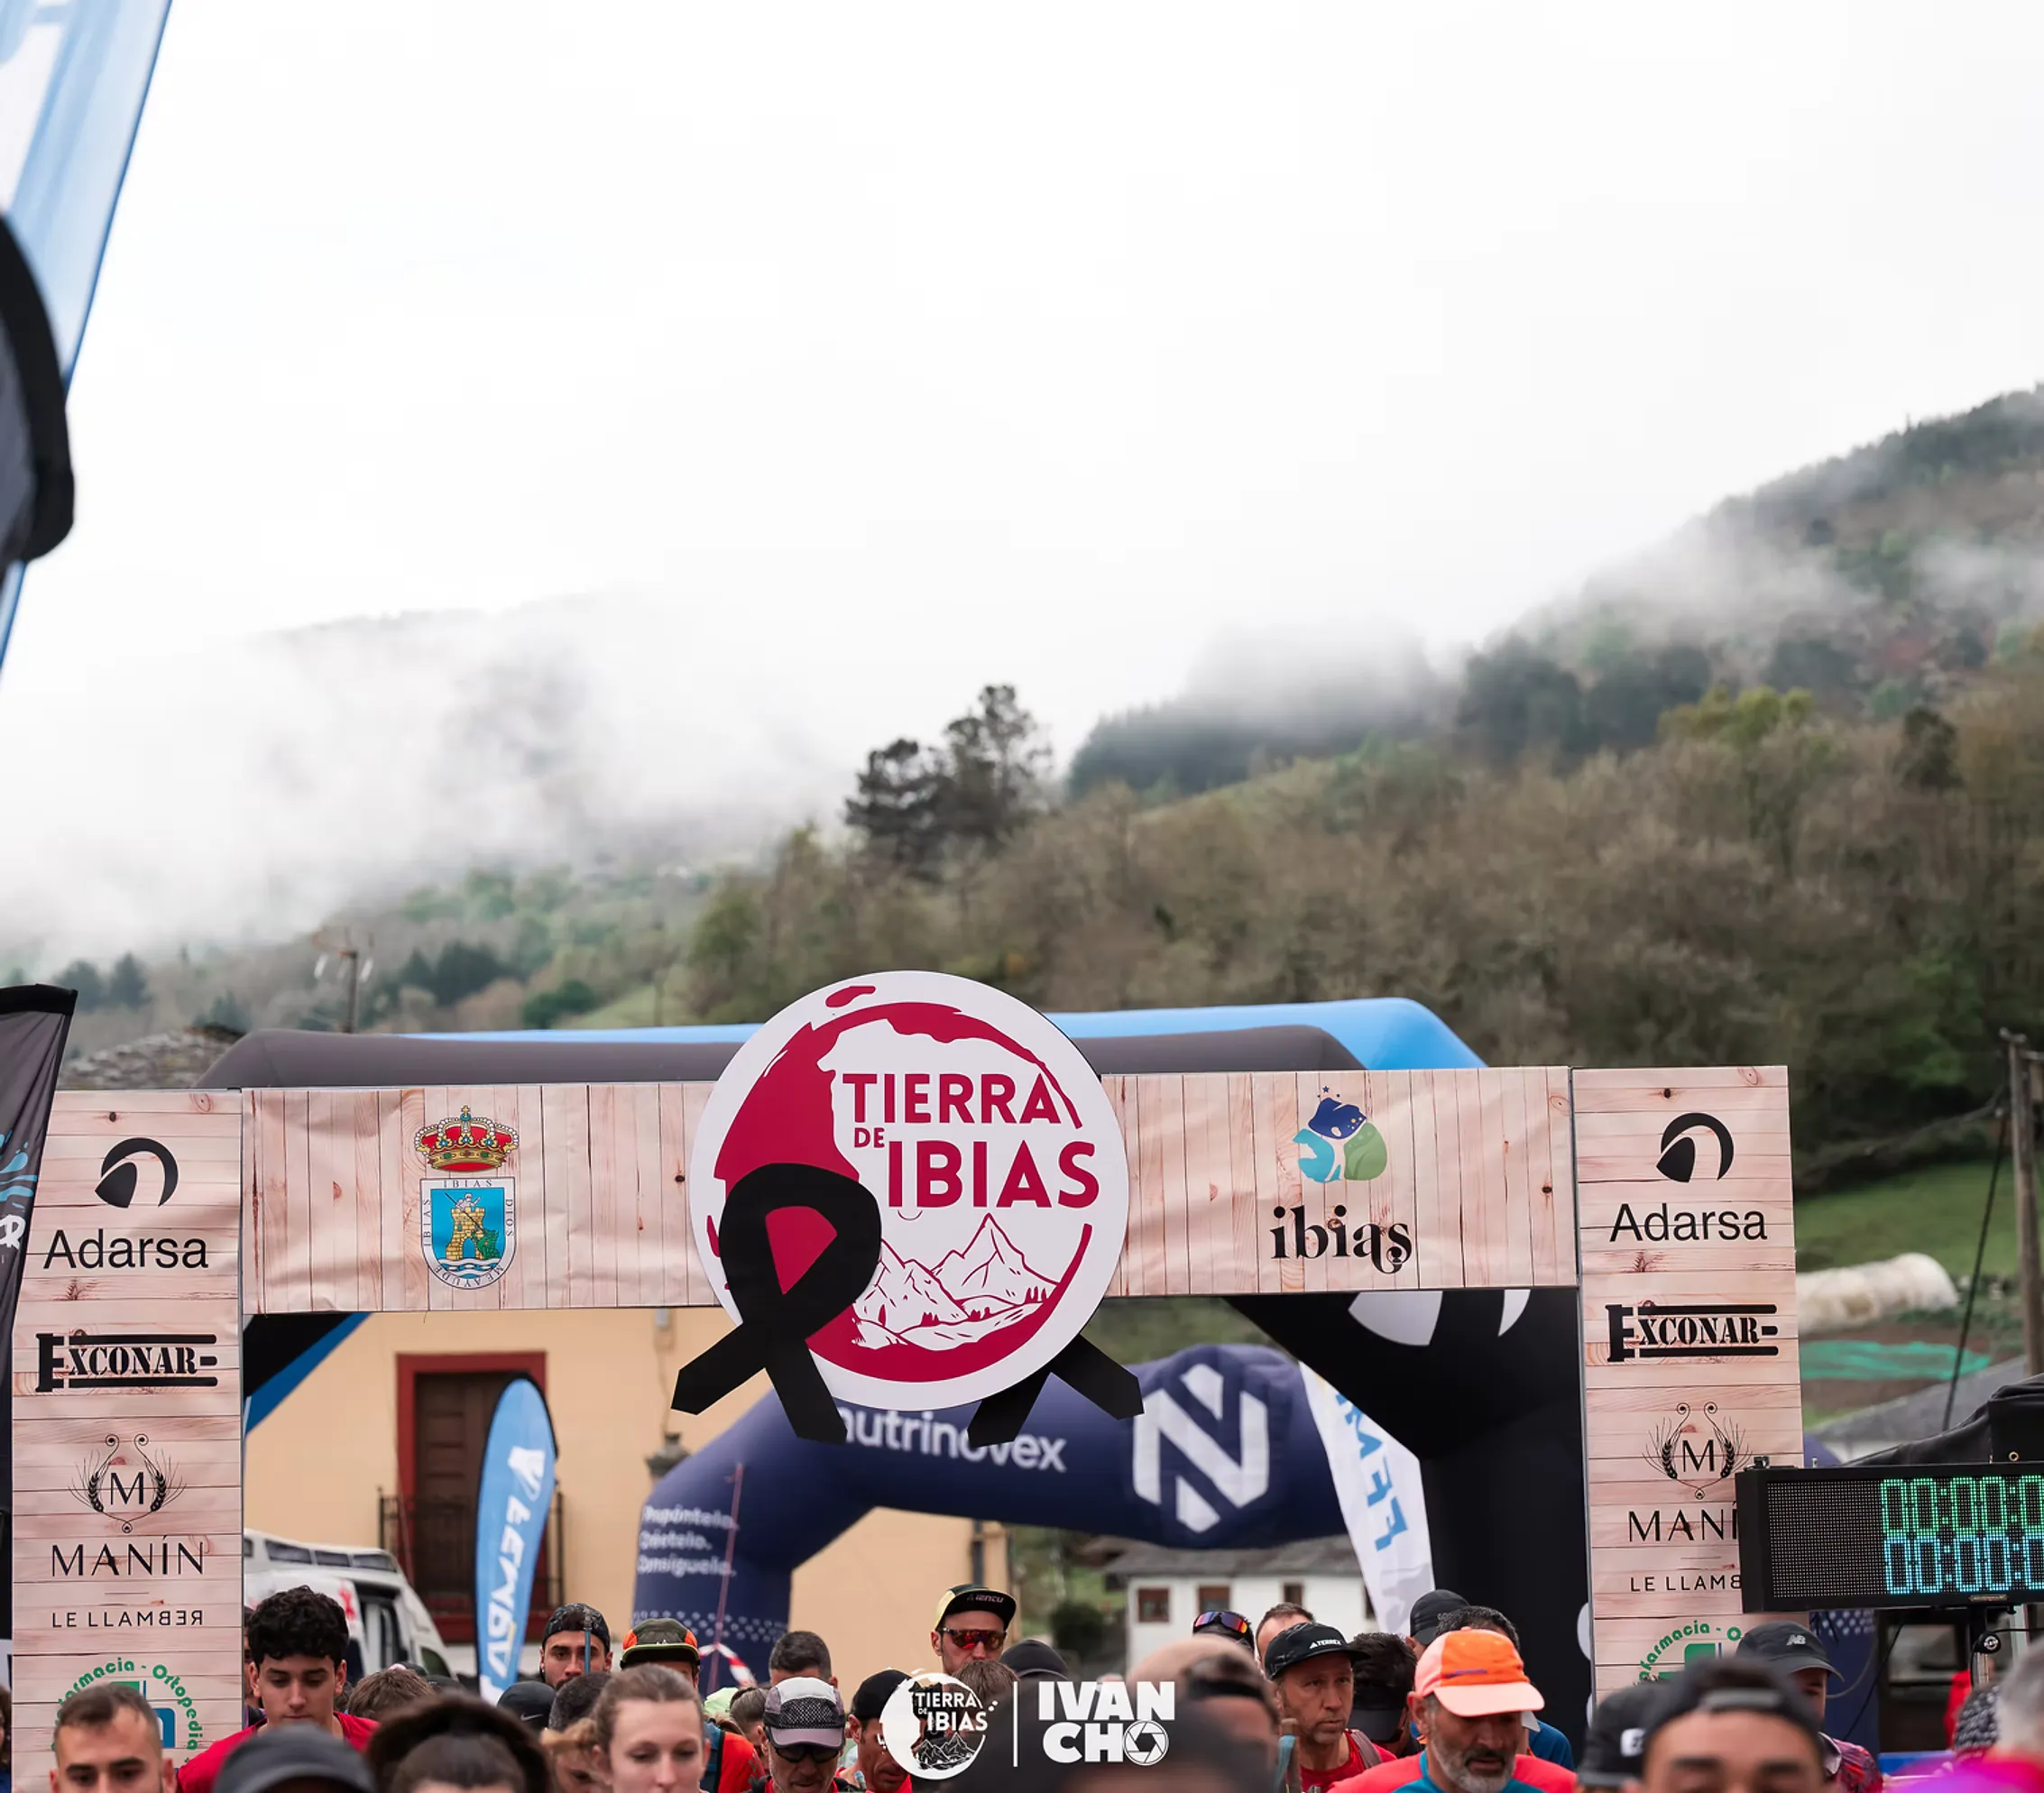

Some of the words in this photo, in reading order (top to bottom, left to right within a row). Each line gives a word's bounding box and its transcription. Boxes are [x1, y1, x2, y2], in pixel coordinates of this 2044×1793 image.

[842, 1072, 1063, 1124] TIERRA
[443, 1179, 493, 1189] IBIAS
[853, 1126, 886, 1148] DE
[888, 1139, 1100, 1209] IBIAS
[1269, 1204, 1413, 1274] ibias
[1609, 1202, 1768, 1242] Adarsa
[43, 1228, 209, 1270] Adarsa
[1605, 1304, 1761, 1363] EXCONAR
[36, 1333, 198, 1393] EXCONAR
[1628, 1500, 1737, 1542] MANÍ
[51, 1534, 204, 1577] MANÍN
[1630, 1577, 1655, 1592] LE
[1665, 1575, 1742, 1591] LLAMB
[52, 1612, 77, 1628] LE
[152, 1664, 203, 1751] Ortopedia
